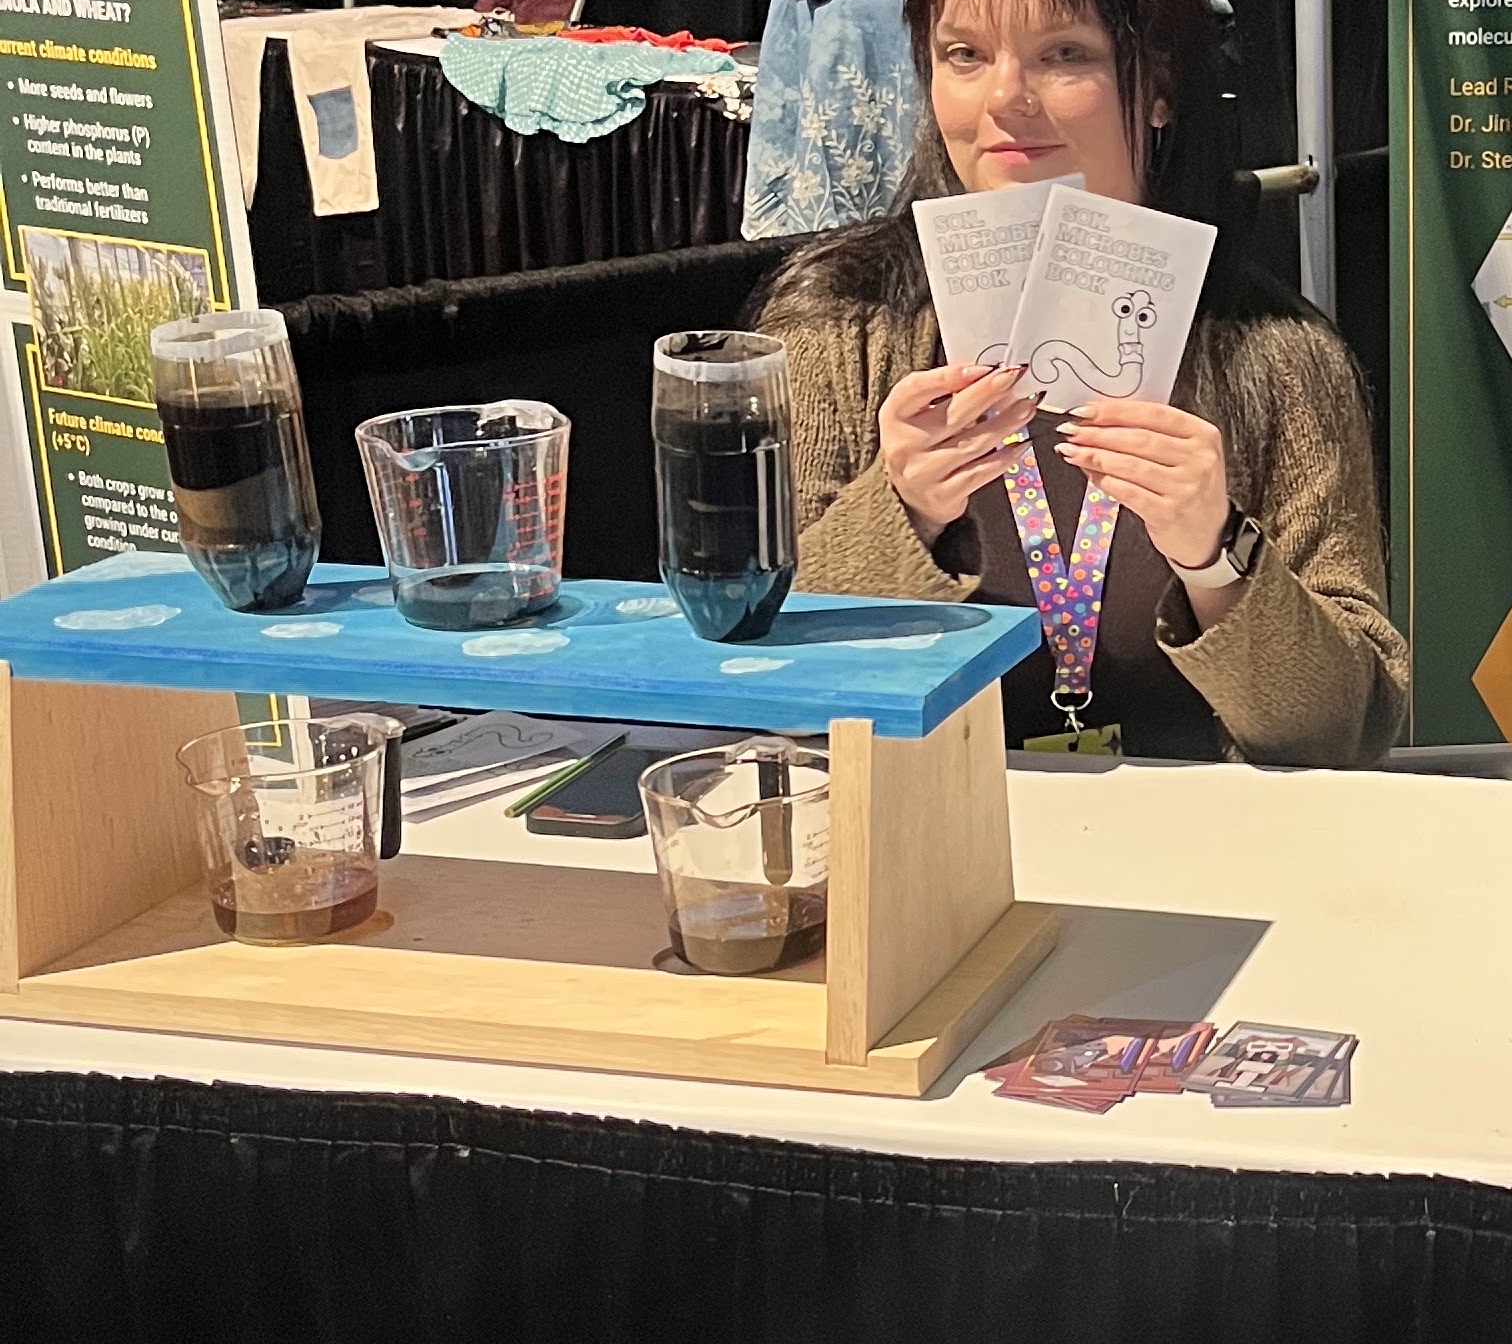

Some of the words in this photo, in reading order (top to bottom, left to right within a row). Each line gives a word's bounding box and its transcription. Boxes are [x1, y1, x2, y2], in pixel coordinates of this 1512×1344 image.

[0, 39, 37, 58] urrent
[39, 40, 86, 62] climate
[89, 46, 157, 69] conditions
[18, 78, 47, 97] More
[49, 83, 84, 102] seeds
[86, 87, 107, 105] and
[109, 87, 153, 108] flowers
[1450, 77, 1497, 96] Lead
[23, 114, 60, 136] Higher
[63, 118, 130, 142] phosphorus
[132, 125, 150, 149] (P)
[1450, 114, 1475, 132] Dr.
[27, 138, 70, 157] content
[71, 142, 83, 158] in
[84, 143, 103, 162] the
[106, 146, 142, 166] plants
[1450, 150, 1474, 169] Dr.
[937, 220, 1040, 254] MICROBE
[1055, 223, 1170, 268] MICROBES
[943, 241, 1034, 274] COLOUR
[1051, 243, 1176, 292] COLOURING
[946, 268, 1010, 295] BOOK
[1045, 262, 1109, 295] BOOK
[48, 407, 87, 430] Future
[89, 416, 134, 438] climate
[78, 470, 104, 489] Both
[105, 478, 136, 496] crops
[138, 485, 165, 500] grow
